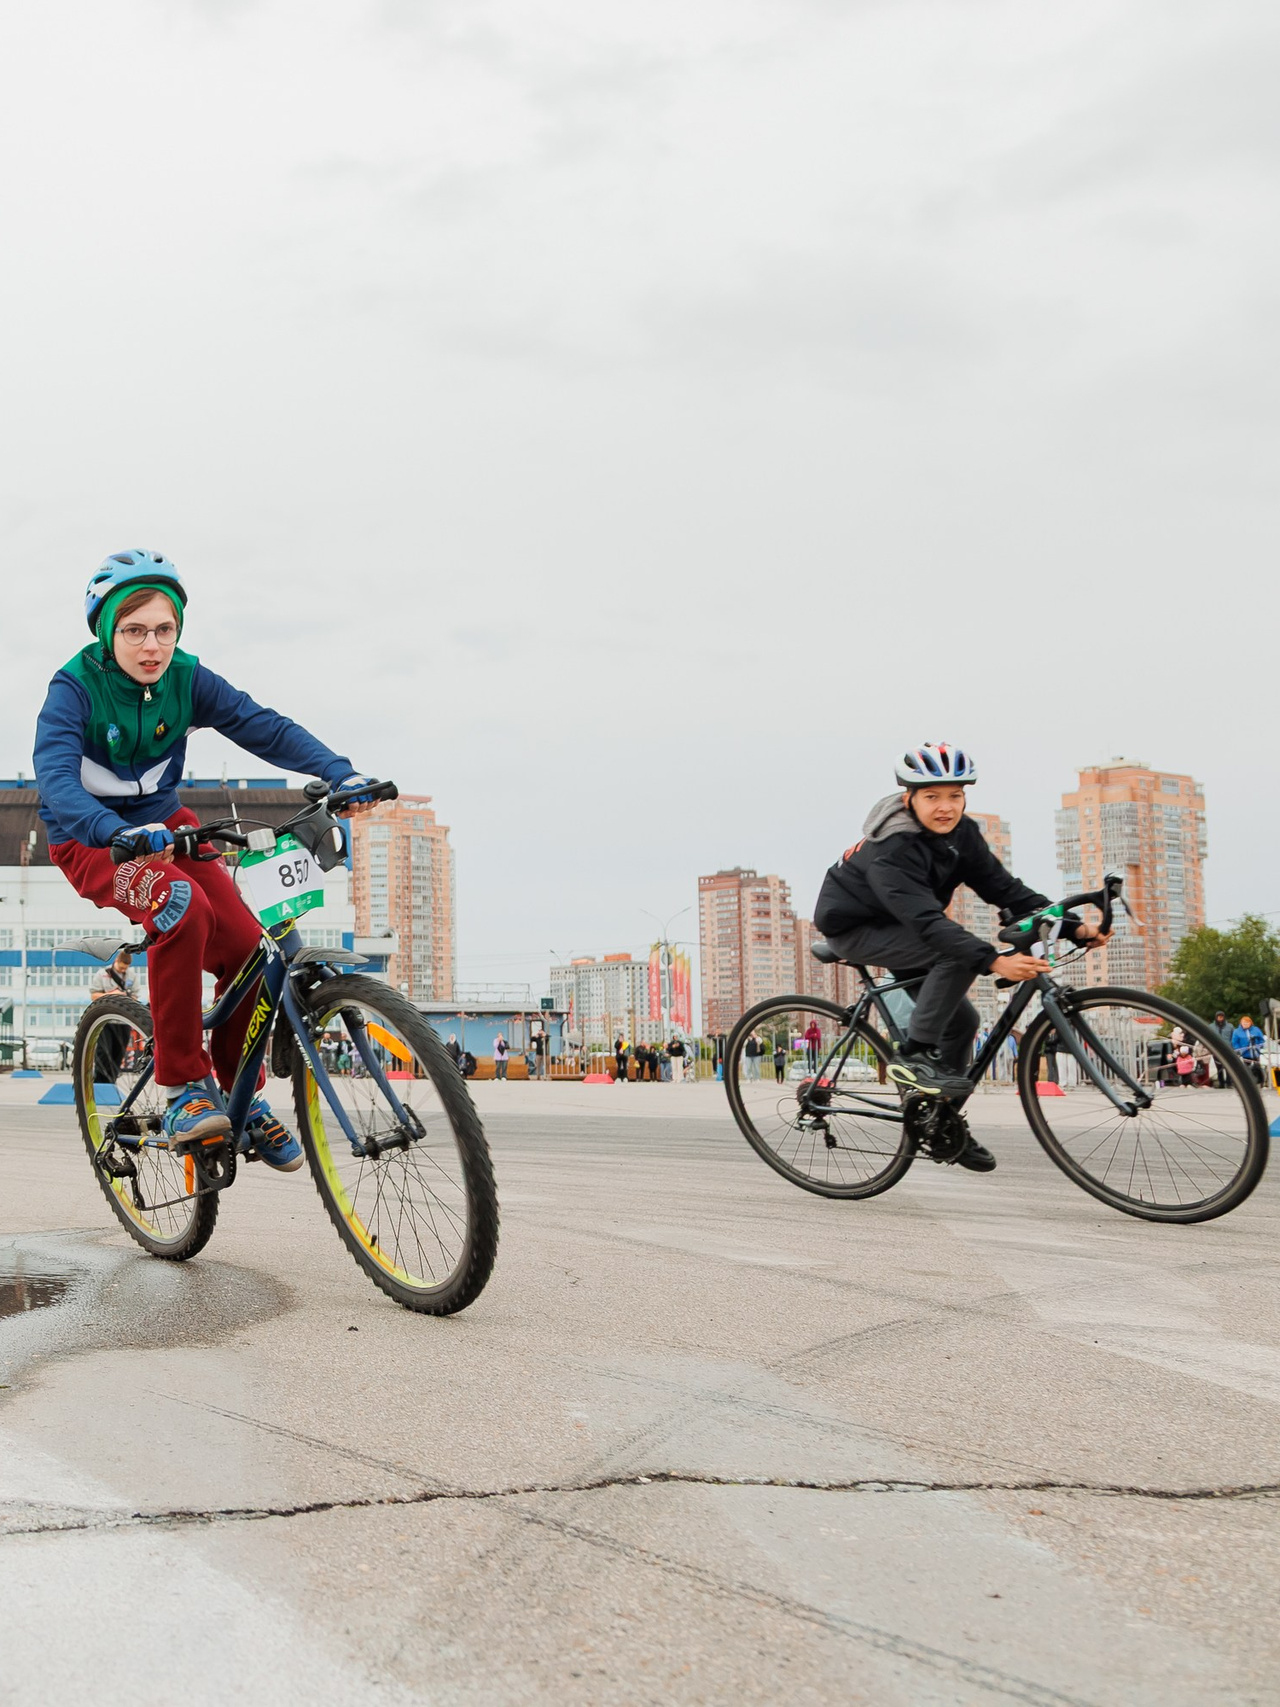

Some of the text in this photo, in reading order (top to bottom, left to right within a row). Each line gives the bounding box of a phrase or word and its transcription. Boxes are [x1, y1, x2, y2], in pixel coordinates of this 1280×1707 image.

[279, 859, 308, 887] 850
[157, 890, 169, 903] EST.
[242, 997, 272, 1057] STERN
